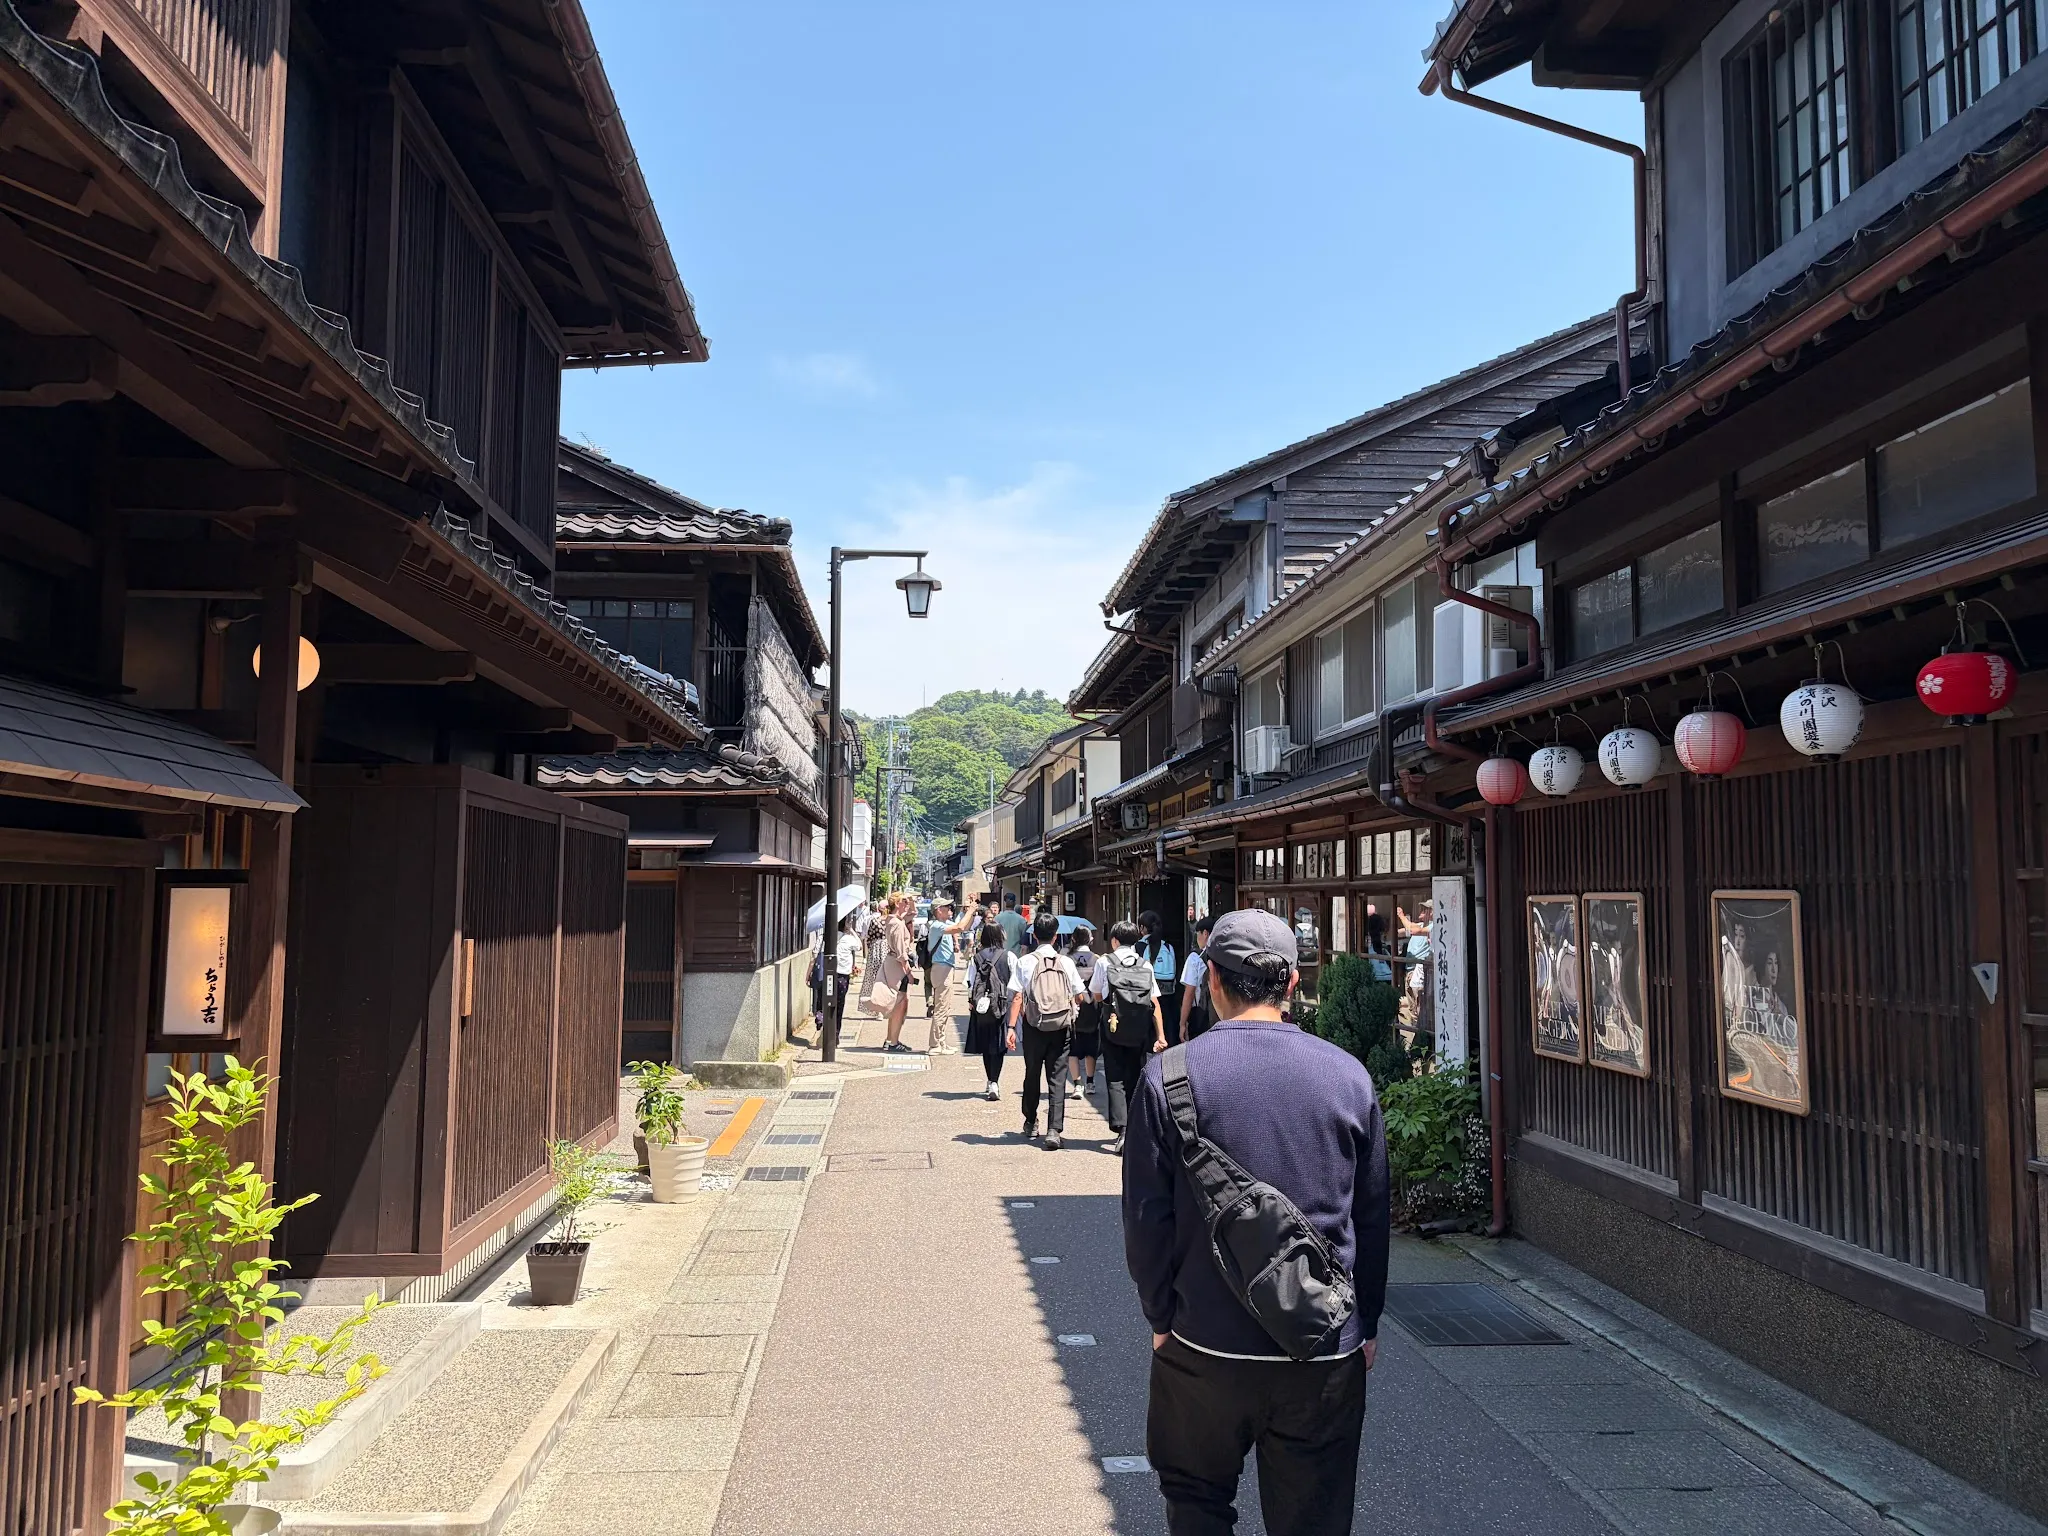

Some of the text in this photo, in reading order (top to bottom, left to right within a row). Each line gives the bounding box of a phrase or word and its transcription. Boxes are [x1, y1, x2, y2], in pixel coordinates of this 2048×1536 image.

[1818, 686, 1838, 707] 金沢
[1622, 731, 1636, 750] 金沢
[1557, 748, 1569, 764] 金沢
[200, 967, 218, 1024] ちょう吉
[1724, 984, 1771, 1009] MEET
[1743, 1009, 1798, 1039] GEIKO
